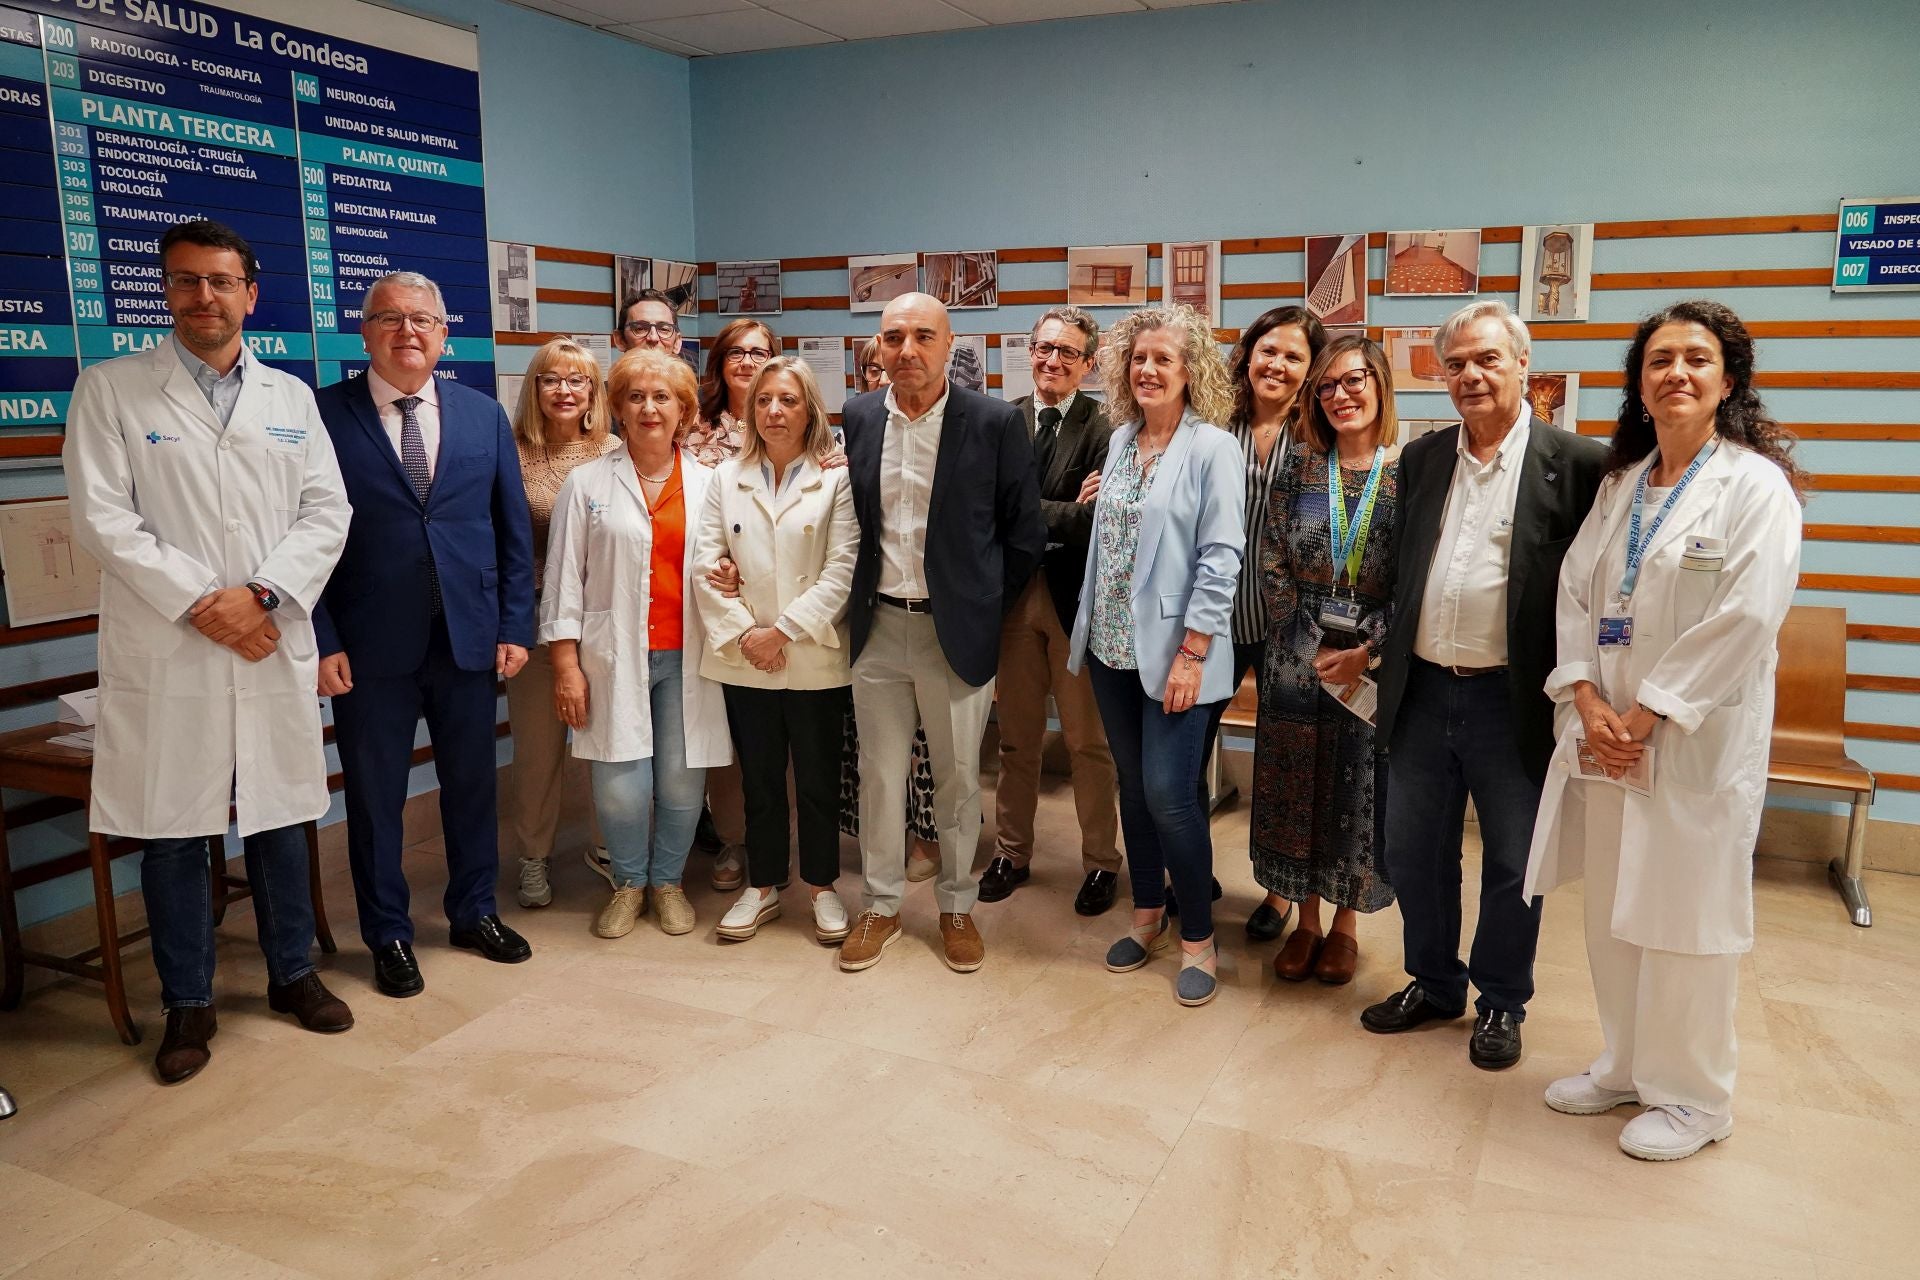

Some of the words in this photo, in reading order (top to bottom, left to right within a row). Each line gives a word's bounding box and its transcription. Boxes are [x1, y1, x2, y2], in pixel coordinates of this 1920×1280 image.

[48, 24, 74, 48] 200
[125, 0, 219, 38] SALUD
[234, 21, 263, 50] La
[270, 31, 369, 74] Condesa
[90, 36, 179, 67] RADIOLOGIA
[191, 59, 262, 84] ECOGRAFIA
[52, 60, 75, 79] 203
[88, 69, 166, 95] DIGESTIVO
[199, 84, 263, 104] TRAUMATOLOGÍA
[296, 79, 317, 98] 406
[326, 87, 396, 112] NEUROLOGÍA
[81, 98, 175, 133] PLANTA
[178, 115, 275, 148] TERCERA
[58, 125, 82, 139] 301
[325, 116, 368, 133] UNIDAD
[371, 125, 385, 136] DE
[387, 128, 419, 143] SALUD
[421, 134, 459, 150] MENTAL
[60, 141, 85, 155] 302
[95, 131, 189, 155] DERMATOLOGÍA
[198, 147, 244, 164] CIRUGÍA
[62, 159, 86, 172] 303
[97, 147, 204, 172] ENDOCRINOLOGÍA
[212, 163, 257, 180] CIRUGÍA
[342, 147, 395, 168] PLANTA
[398, 156, 448, 176] QUINTA
[63, 176, 88, 188] 304
[98, 164, 168, 184] TOCOLOGÍA
[304, 167, 324, 185] 500
[332, 173, 392, 192] PEDIATRIA
[100, 180, 163, 198] UROLOGÍA
[66, 194, 89, 206] 305
[306, 193, 324, 204] 501
[67, 211, 91, 222] 306
[308, 207, 325, 217] 503
[335, 202, 388, 219] MEDICINA
[390, 209, 437, 225] FAMILIAR
[1845, 211, 1868, 228] 006
[69, 231, 95, 252] 307
[309, 226, 327, 241] 502
[335, 226, 389, 240] NEUMOLOGÍA
[108, 238, 161, 254] CIRUGÍ
[1848, 239, 1895, 250] VISADO
[1897, 239, 1914, 249] DE
[311, 251, 329, 261] 504
[338, 253, 389, 266] TOCOLOGÍA
[73, 262, 96, 274] 308
[312, 265, 330, 274] 509
[1842, 263, 1865, 277] 007
[75, 278, 98, 289] 309
[111, 281, 165, 293] CARDIOL
[313, 282, 333, 301] 511
[339, 280, 365, 291] E.C.G.
[76, 299, 102, 319] 310
[316, 311, 335, 328] 510
[248, 336, 288, 354] RTA
[1663, 460, 1701, 510] ENFERMERA
